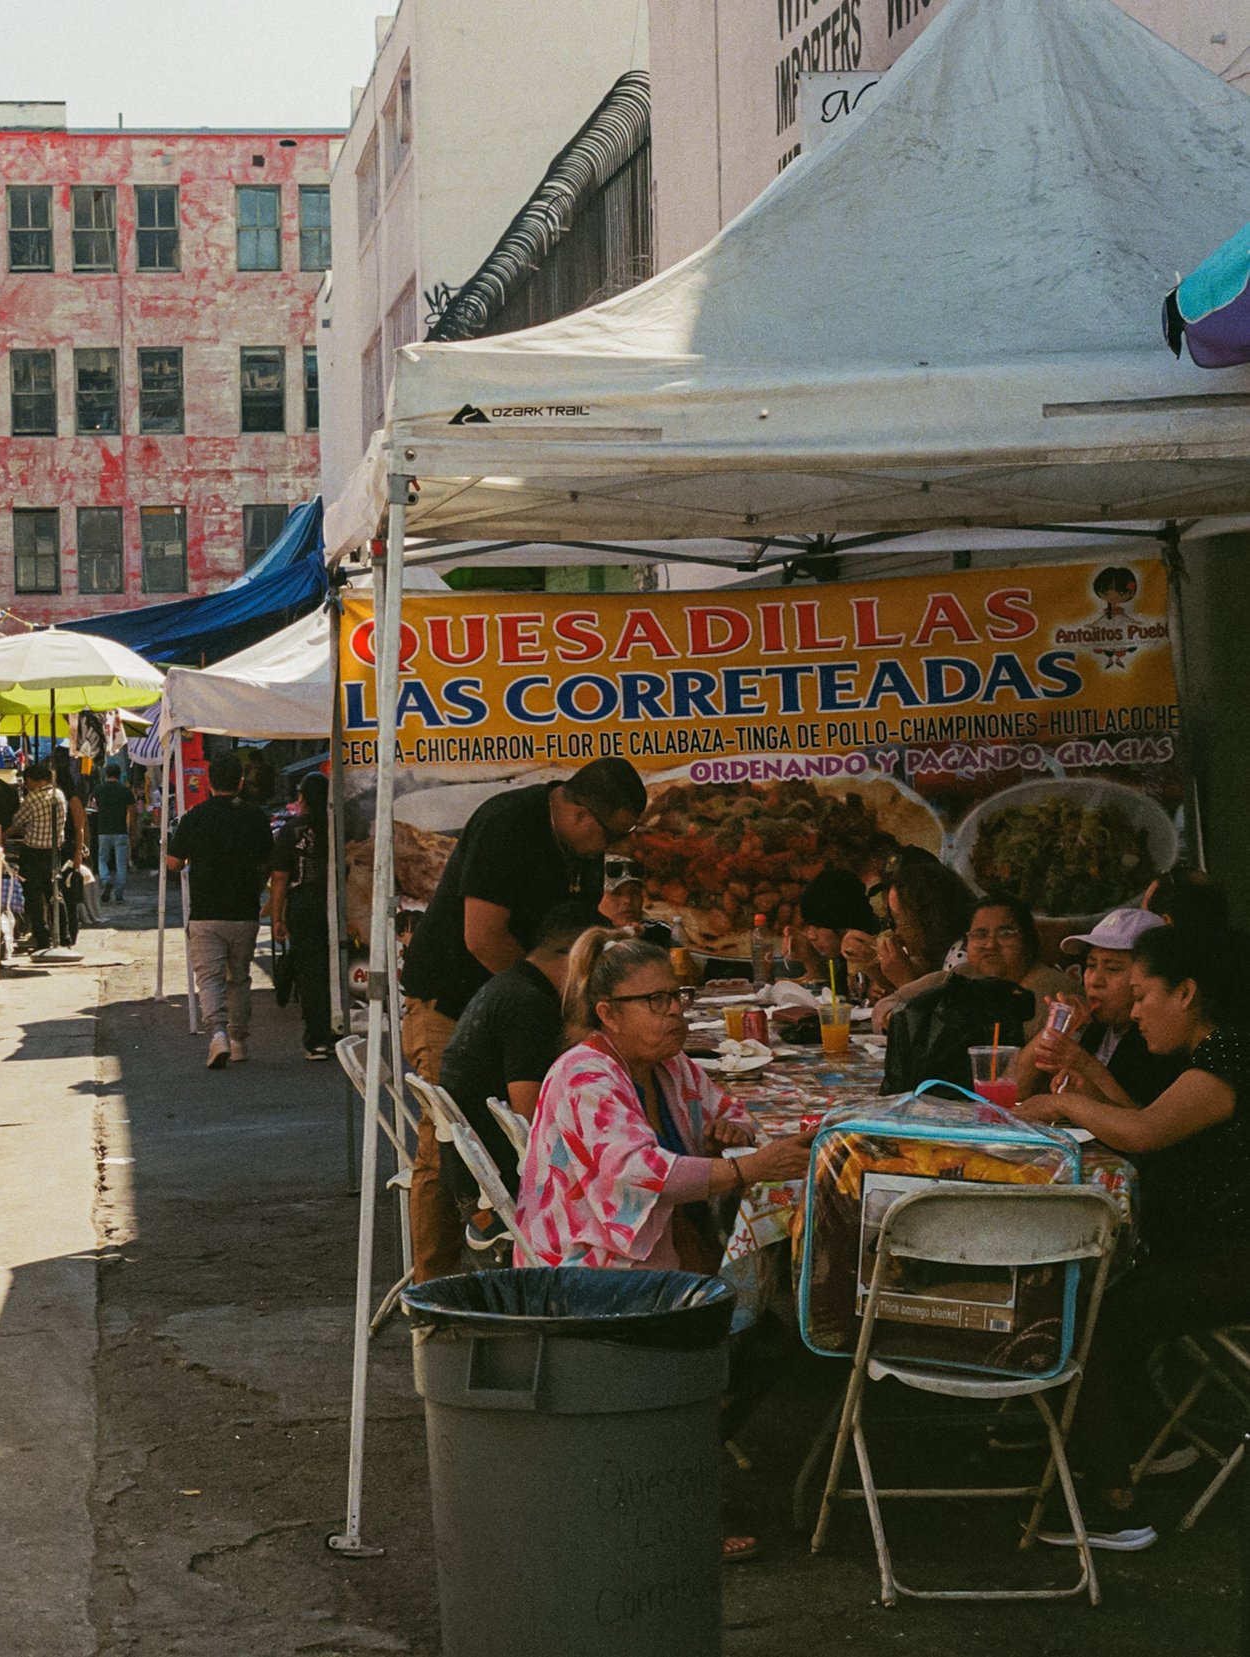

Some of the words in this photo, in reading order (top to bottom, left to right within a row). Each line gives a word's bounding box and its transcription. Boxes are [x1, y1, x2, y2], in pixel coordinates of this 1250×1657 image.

[350, 587, 1038, 675] QUESADILLAS
[1055, 626, 1124, 644] Antojitos
[343, 677, 489, 731] LAS
[503, 651, 1083, 726] CORRETEADAS
[342, 733, 594, 766] CECIA-CHICHARRON-FLOR
[601, 732, 624, 757] DE
[630, 725, 792, 756] CALABAZA-TINGA
[798, 723, 821, 749] DE
[827, 704, 1180, 747] POLLO-CHAMPINONES-HUITLACOCHE
[689, 753, 868, 784] ORDENANDO
[876, 750, 899, 774] Y
[1056, 737, 1175, 768] GRACIAS
[880, 1300, 899, 1314] Thick
[931, 1306, 959, 1321] blanket
